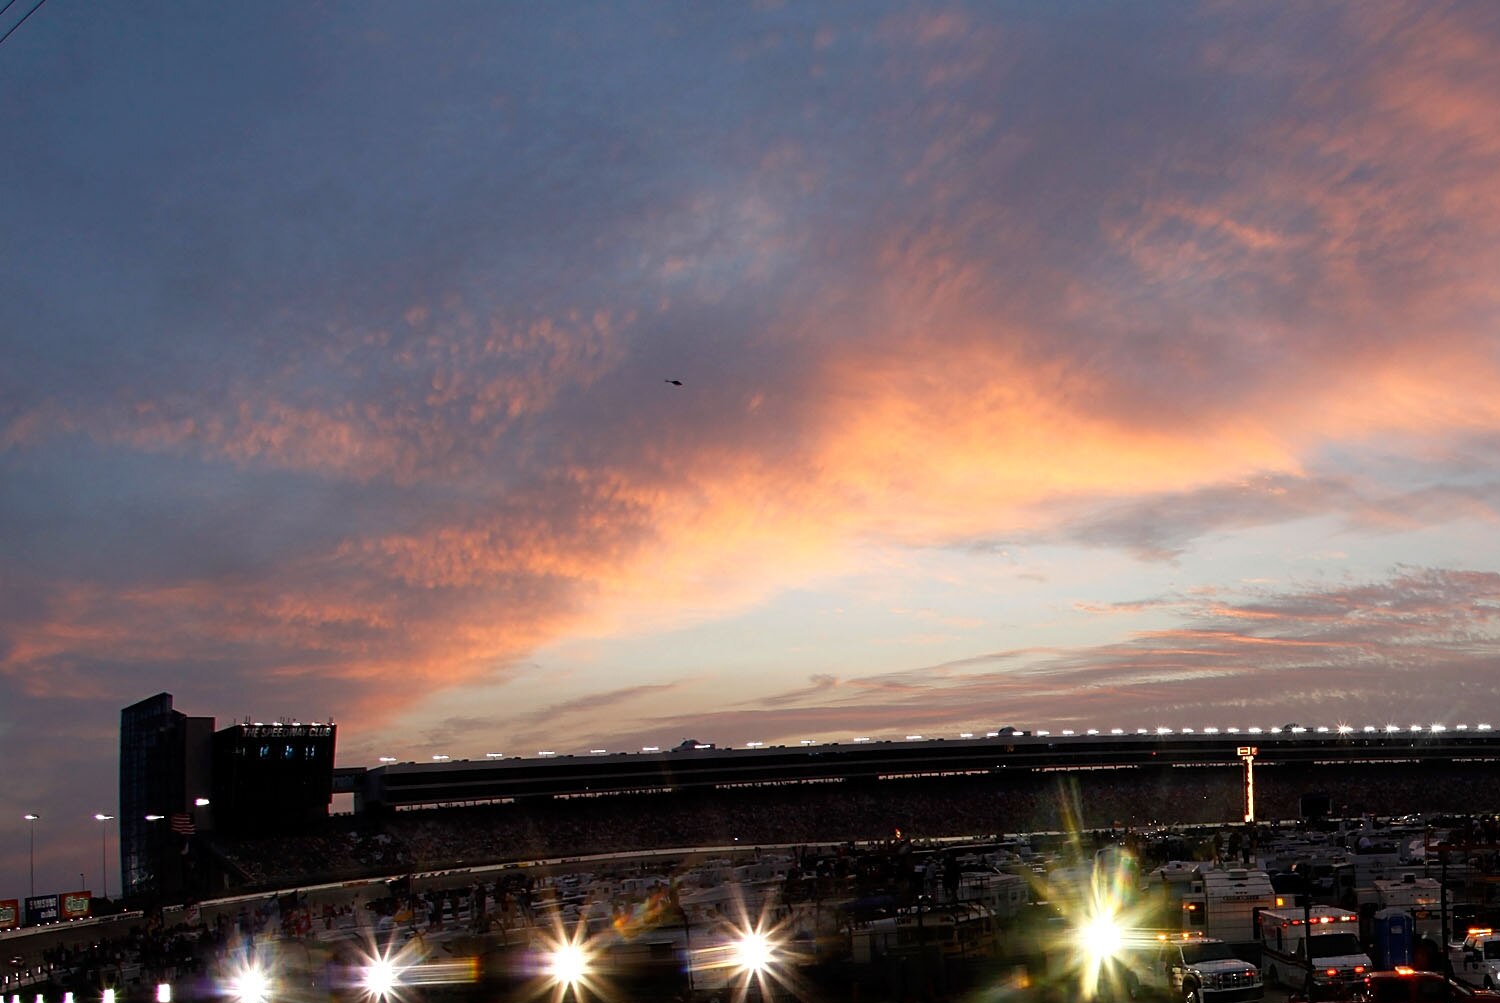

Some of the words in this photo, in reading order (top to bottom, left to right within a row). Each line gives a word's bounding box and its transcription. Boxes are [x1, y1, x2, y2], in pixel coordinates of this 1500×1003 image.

[242, 727, 259, 738] THE
[261, 727, 307, 738] SPEEDWAY
[309, 727, 331, 737] CLUB
